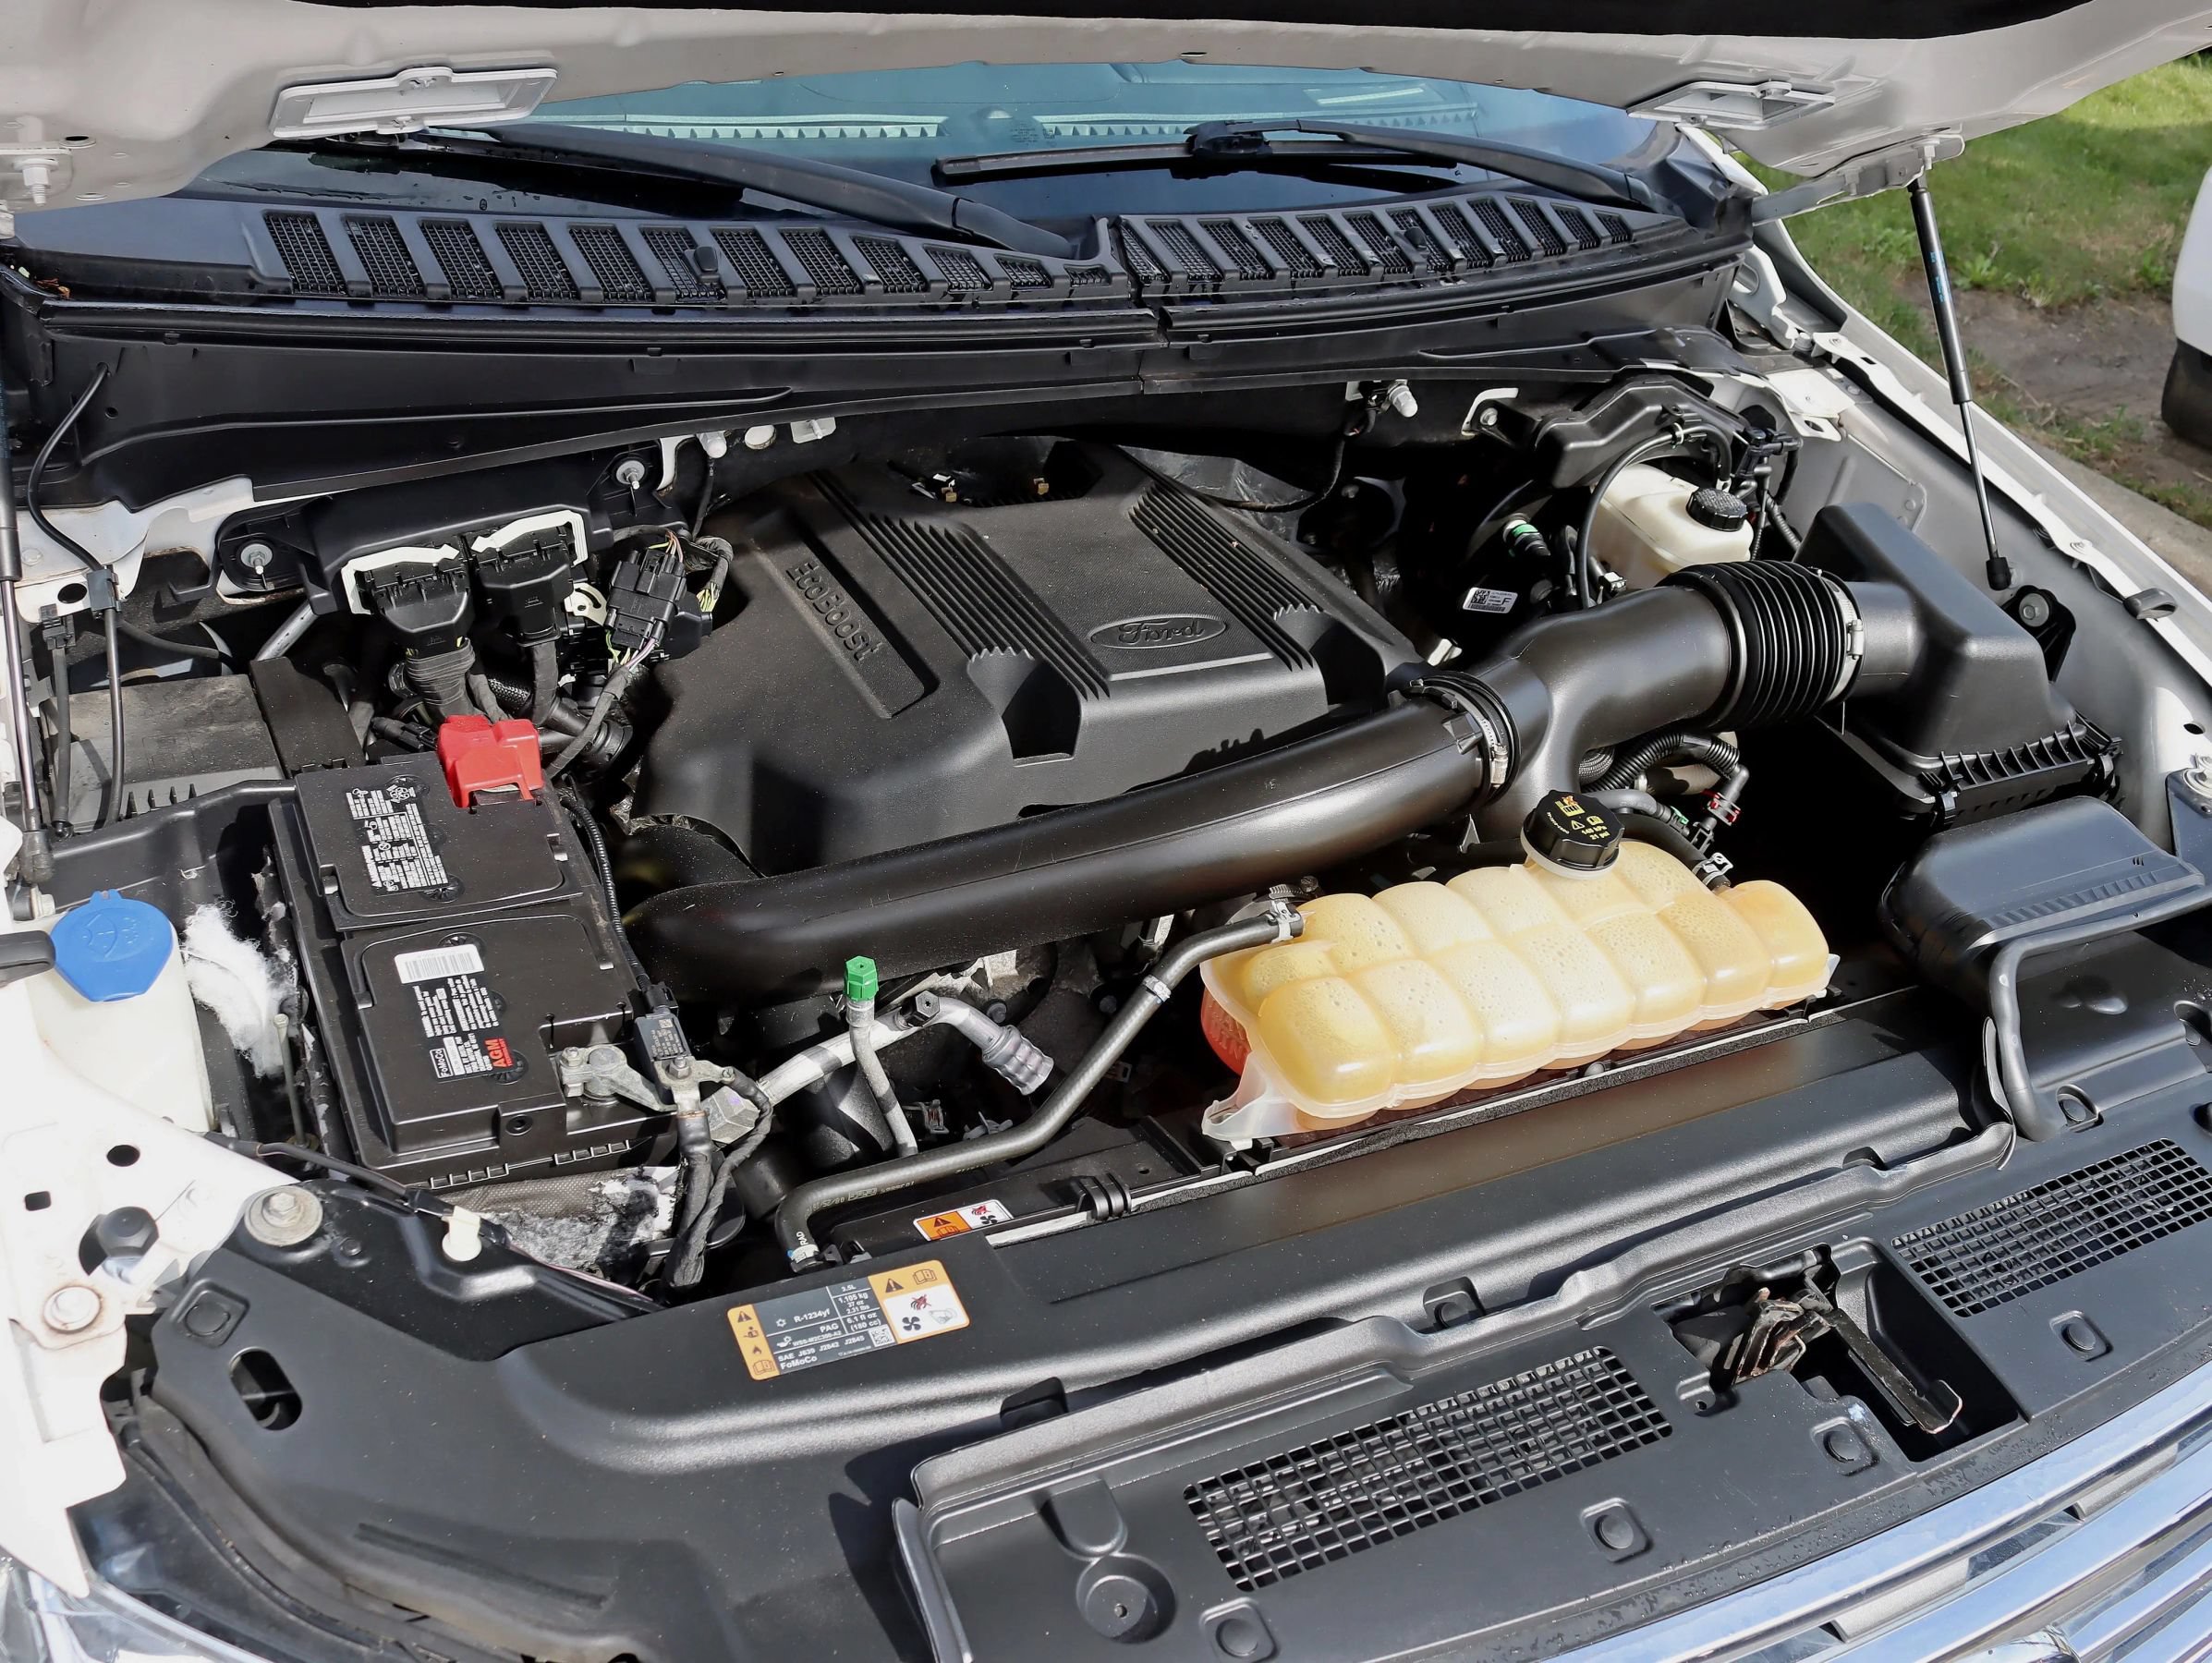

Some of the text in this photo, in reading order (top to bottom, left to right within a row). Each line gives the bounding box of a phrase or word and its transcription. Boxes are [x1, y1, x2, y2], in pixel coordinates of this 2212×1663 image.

[785, 561, 883, 662] EcoBoost
[1118, 617, 1205, 645] Ford
[485, 1038, 507, 1068] AGM
[435, 1050, 451, 1078] FoMoCo
[796, 1231, 809, 1246] RAD
[841, 1284, 857, 1293] 3.5L
[857, 1292, 869, 1301] kg
[793, 1308, 831, 1324] R-1234yf
[868, 1312, 878, 1320] oz
[820, 1323, 839, 1333] PAG
[850, 1318, 881, 1332] (180 cc)
[778, 1353, 795, 1363] SAE
[780, 1355, 818, 1370] FoMoCo
